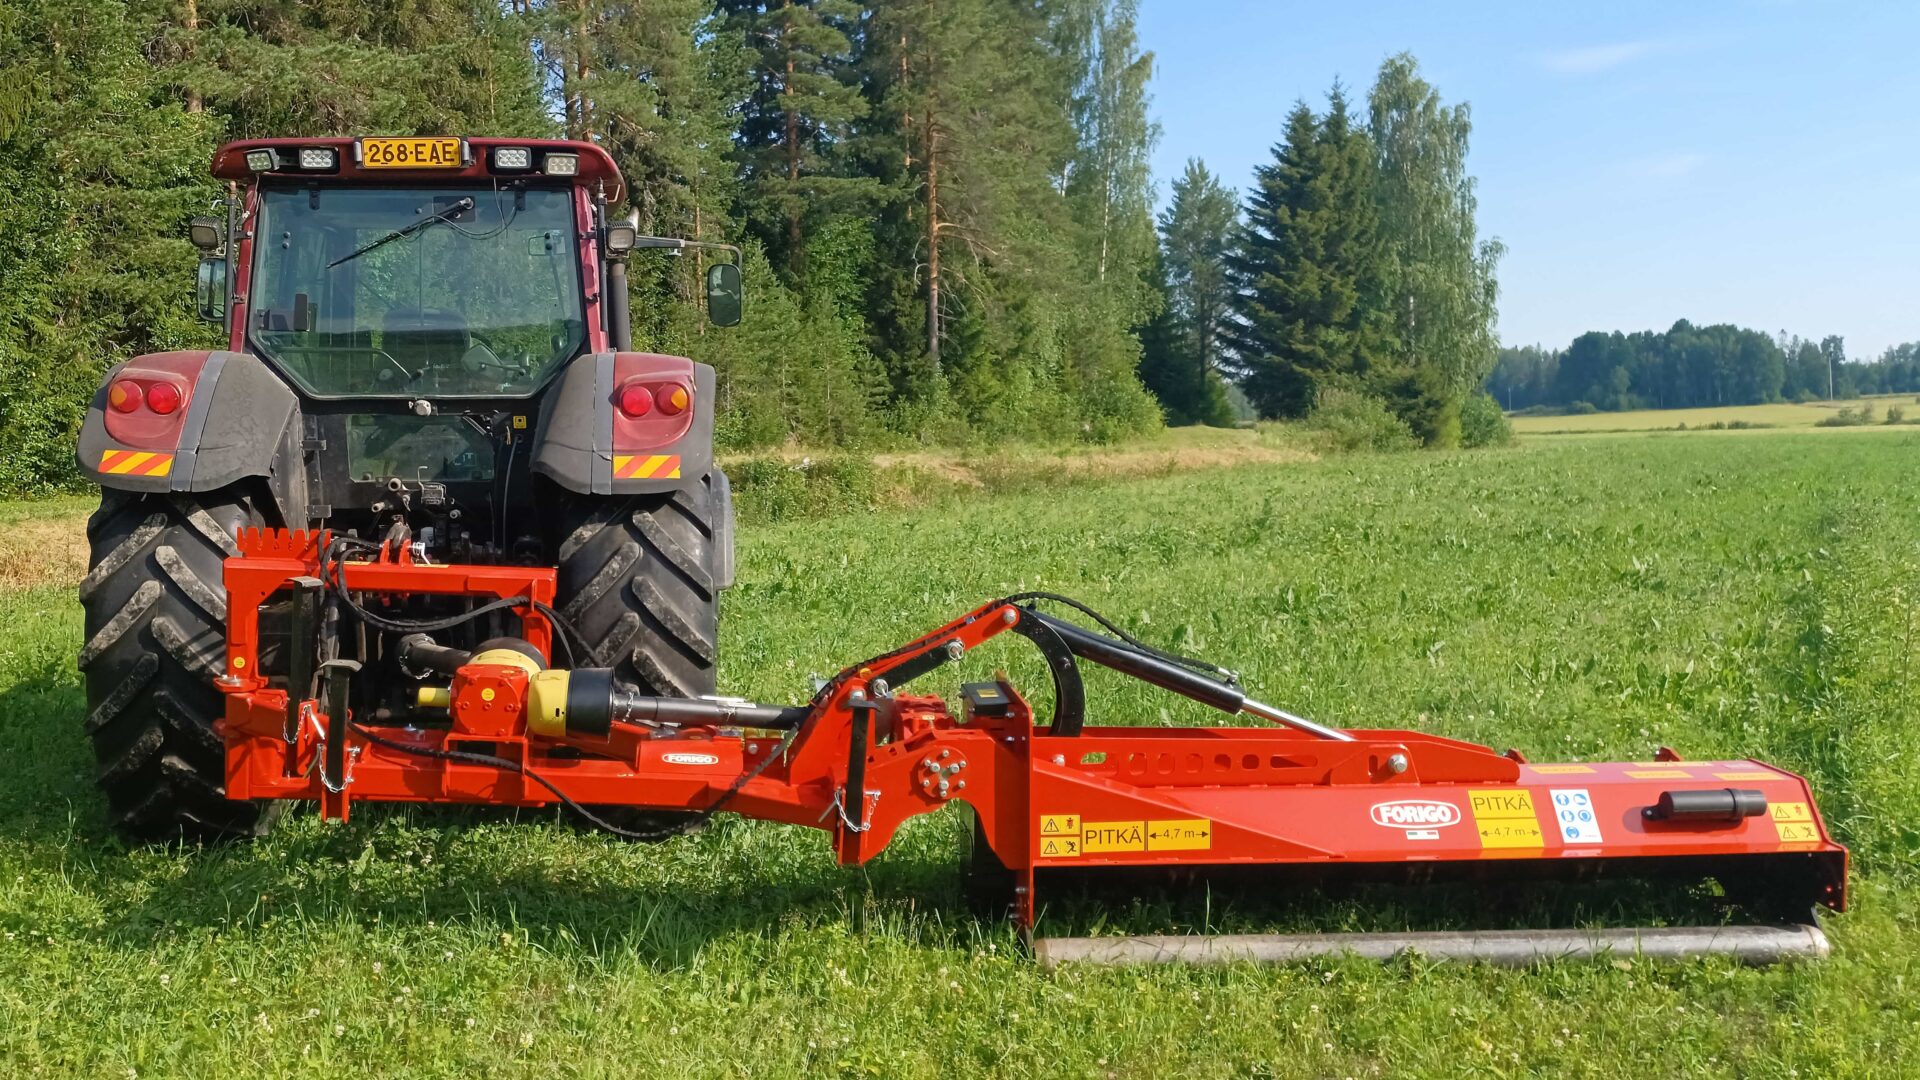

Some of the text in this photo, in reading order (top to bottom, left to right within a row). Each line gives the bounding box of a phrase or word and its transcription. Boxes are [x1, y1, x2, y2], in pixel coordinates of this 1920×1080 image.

[667, 754, 714, 764] FORIGO
[1473, 794, 1532, 811] PITKÄ
[1379, 804, 1452, 823] FORIGO
[1085, 825, 1143, 845] PITKÄ
[1163, 828, 1195, 840] 4,7 m
[1494, 825, 1510, 837] 4,7
